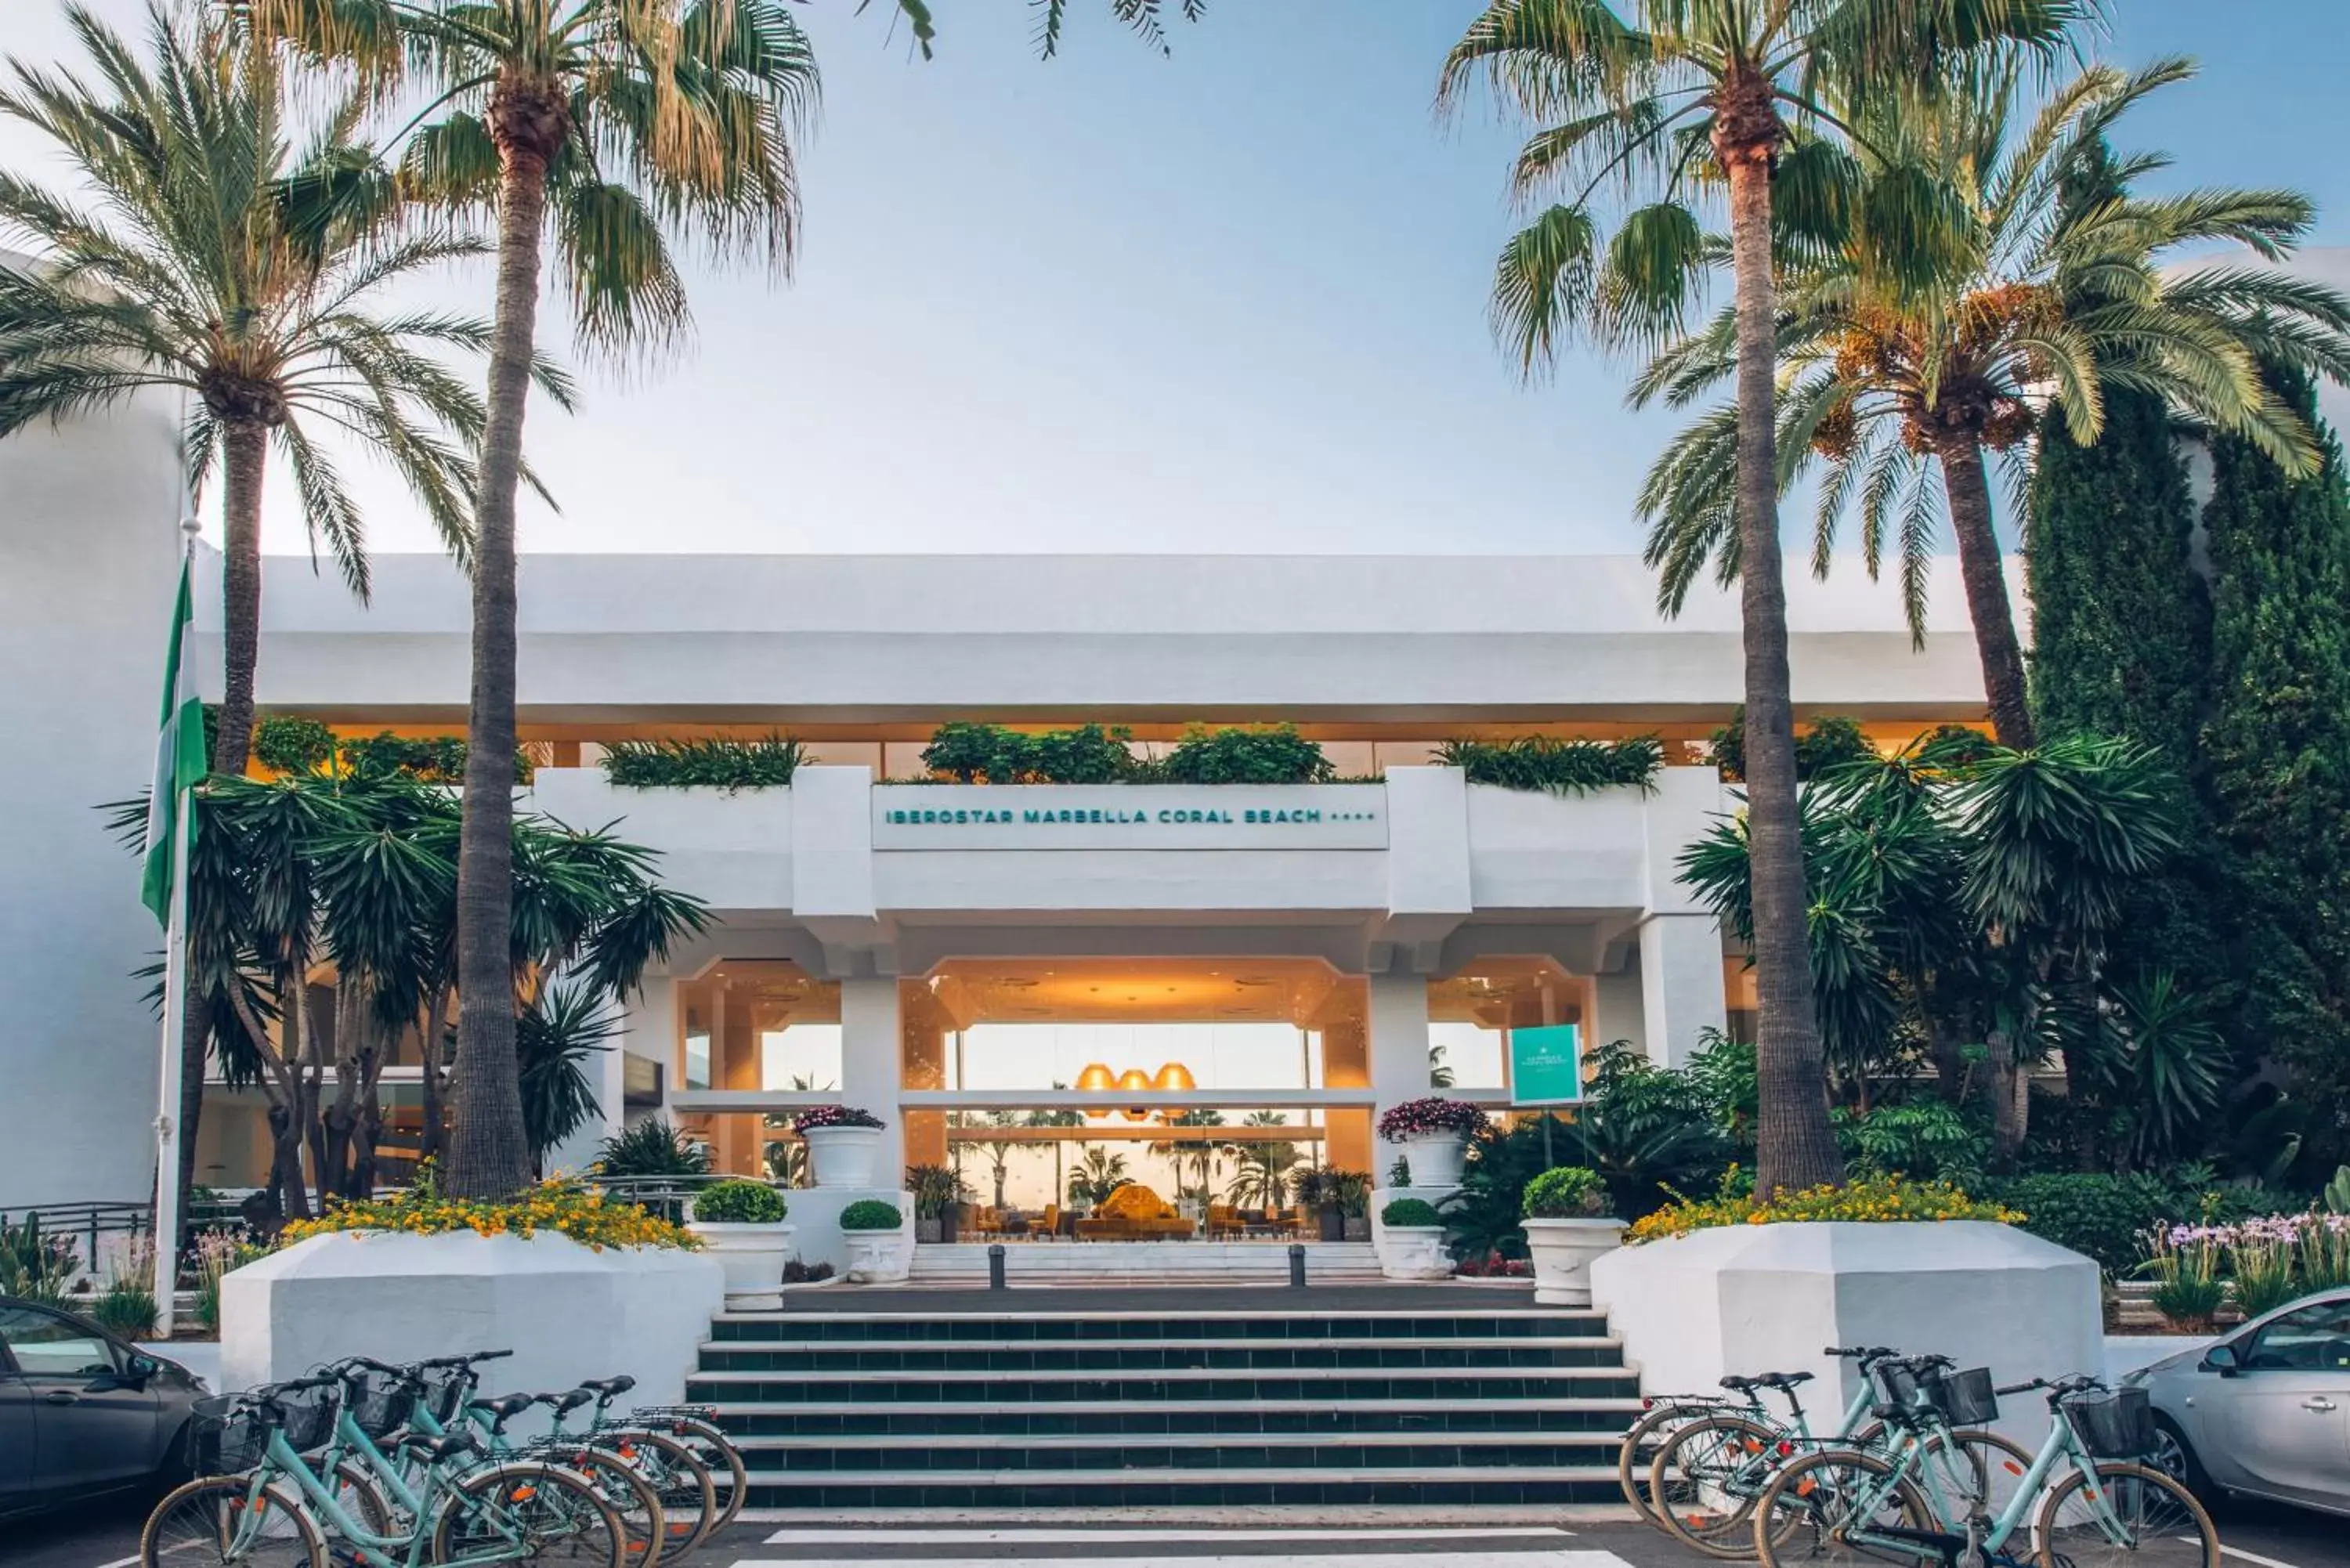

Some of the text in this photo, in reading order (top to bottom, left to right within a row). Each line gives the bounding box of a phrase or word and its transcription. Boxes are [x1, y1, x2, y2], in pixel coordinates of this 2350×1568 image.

[886, 809, 1321, 824] IBEROSTAR MARBELLA CORAL BEACH
